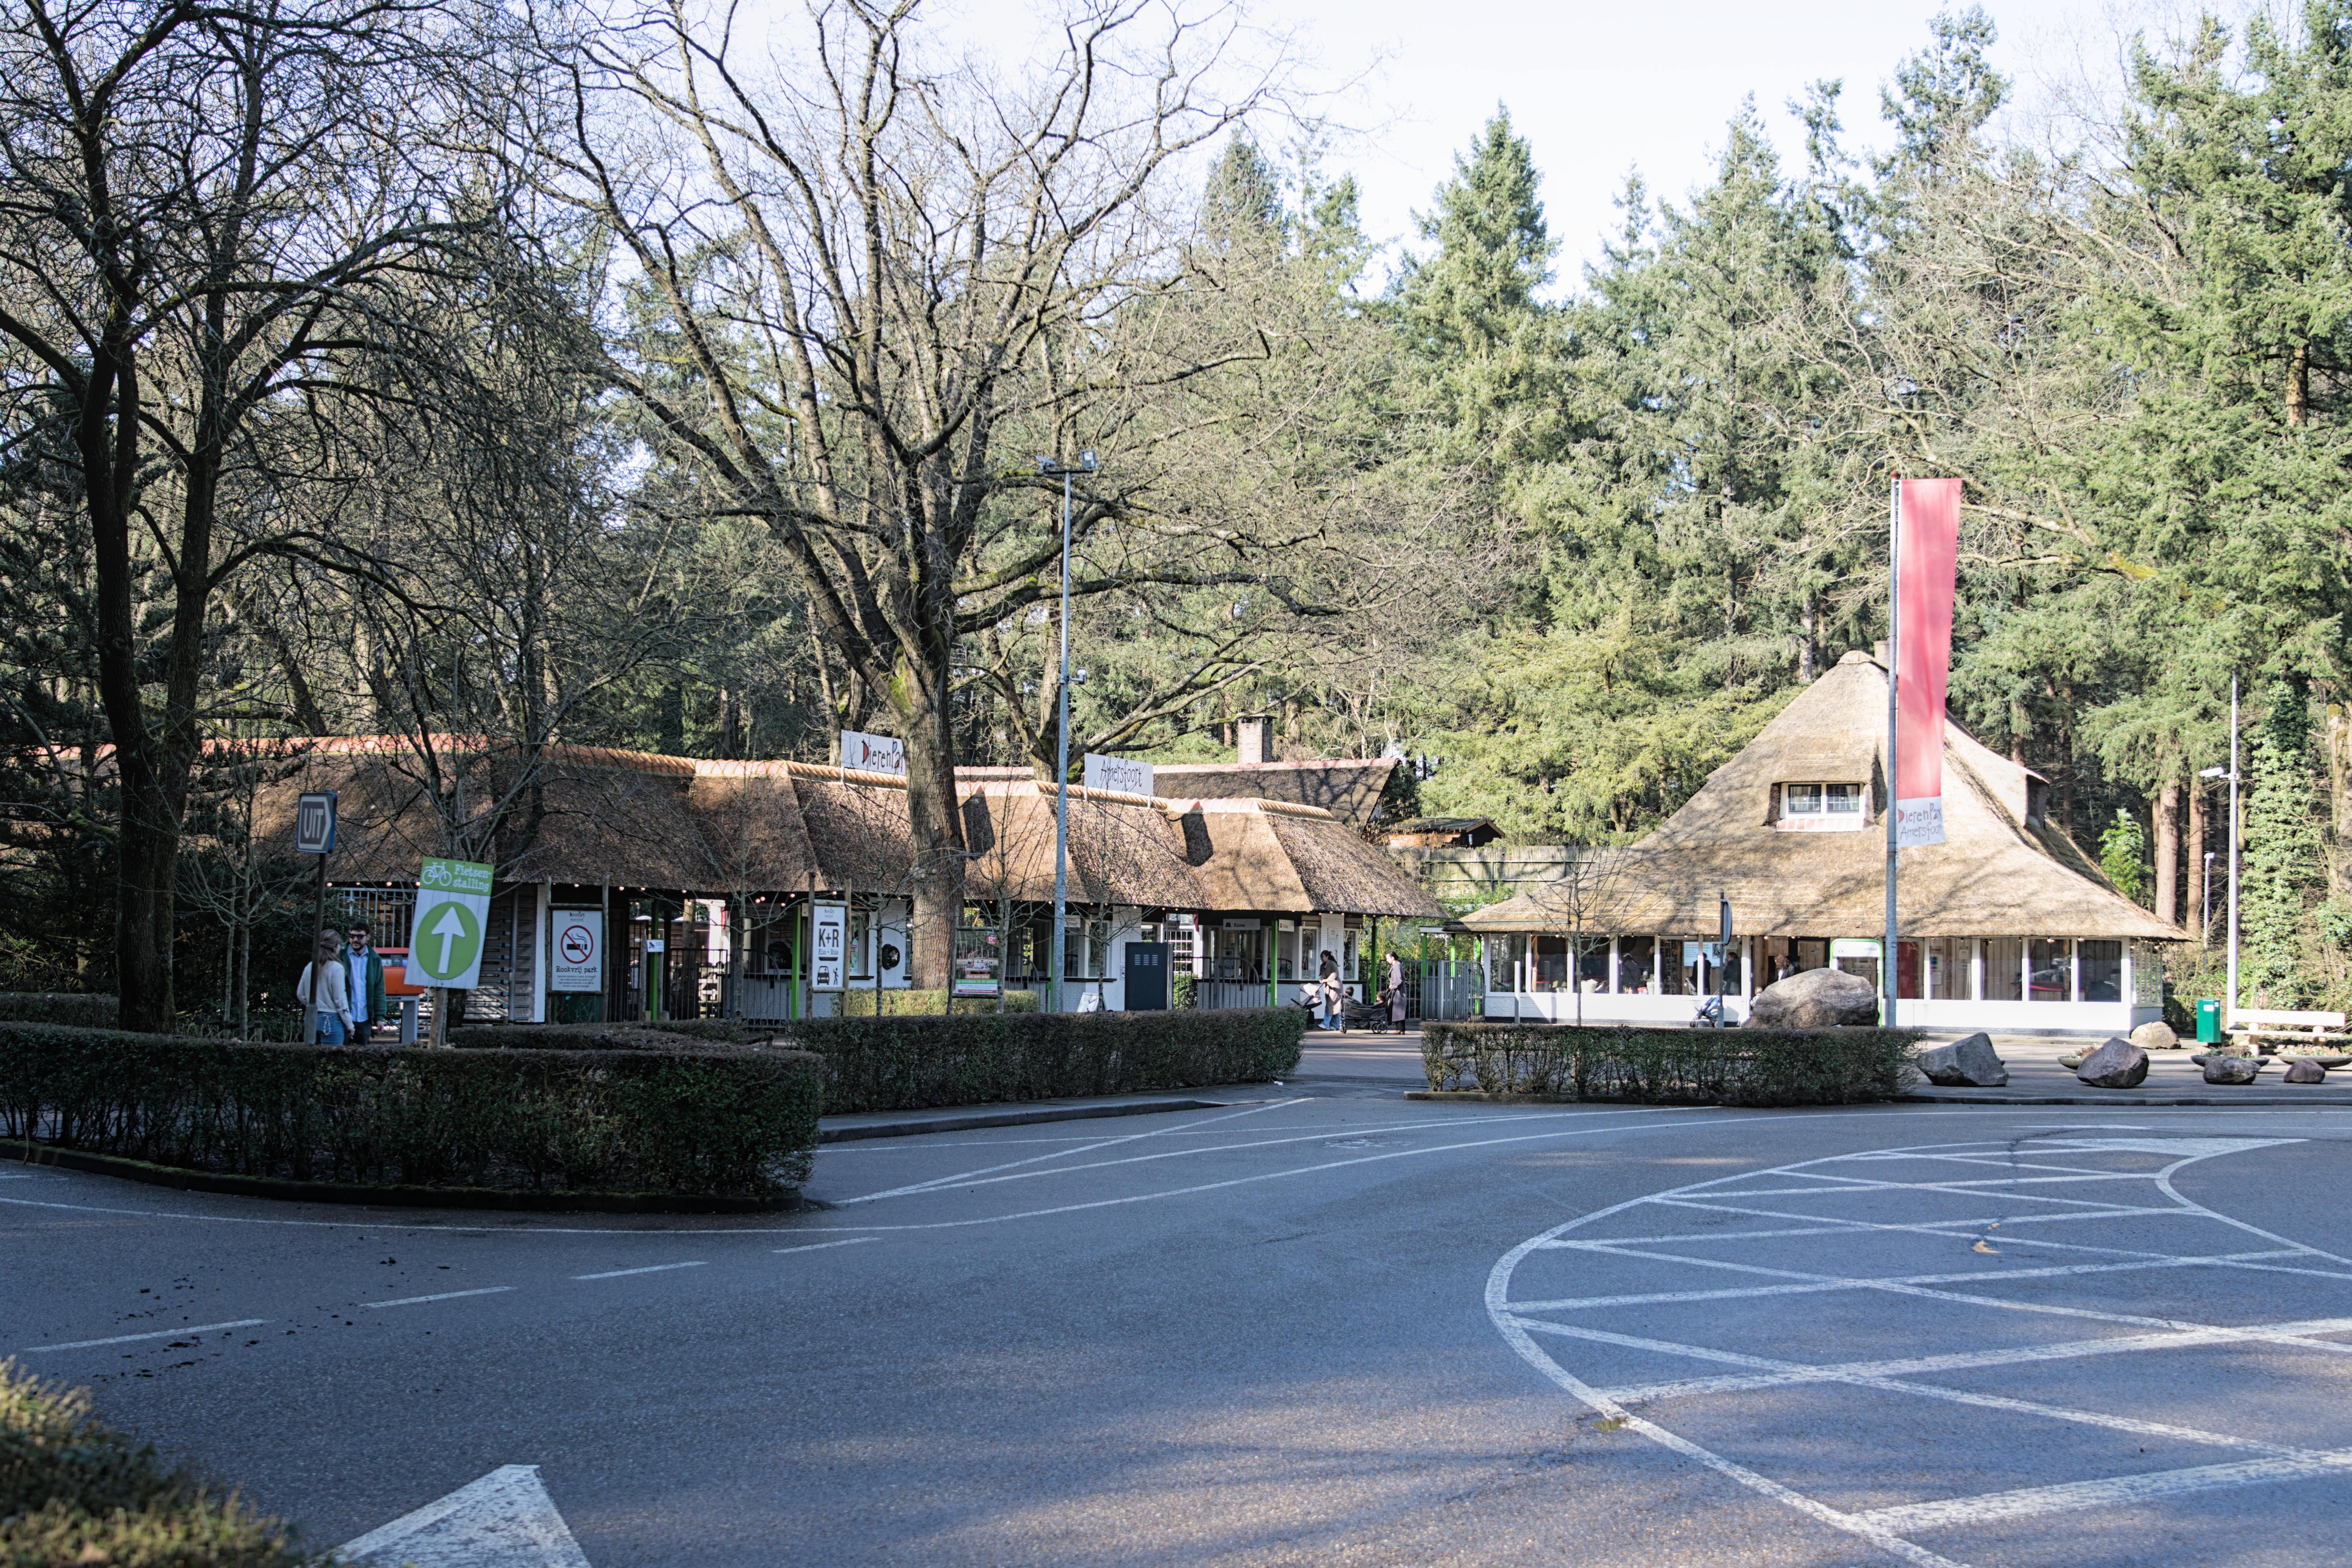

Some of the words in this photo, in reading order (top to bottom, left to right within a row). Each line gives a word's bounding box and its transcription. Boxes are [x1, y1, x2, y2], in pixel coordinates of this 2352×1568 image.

[862, 739, 904, 772] DierenPar
[1100, 759, 1142, 787] Amersfoort
[1897, 802, 1942, 824] DierenPark
[304, 808, 324, 839] UIT
[1900, 822, 1942, 841] Amersfoor
[454, 864, 492, 879] Fietsen-
[453, 877, 489, 892] stalling
[819, 929, 839, 947] K+R
[556, 966, 582, 974] Rookvrij
